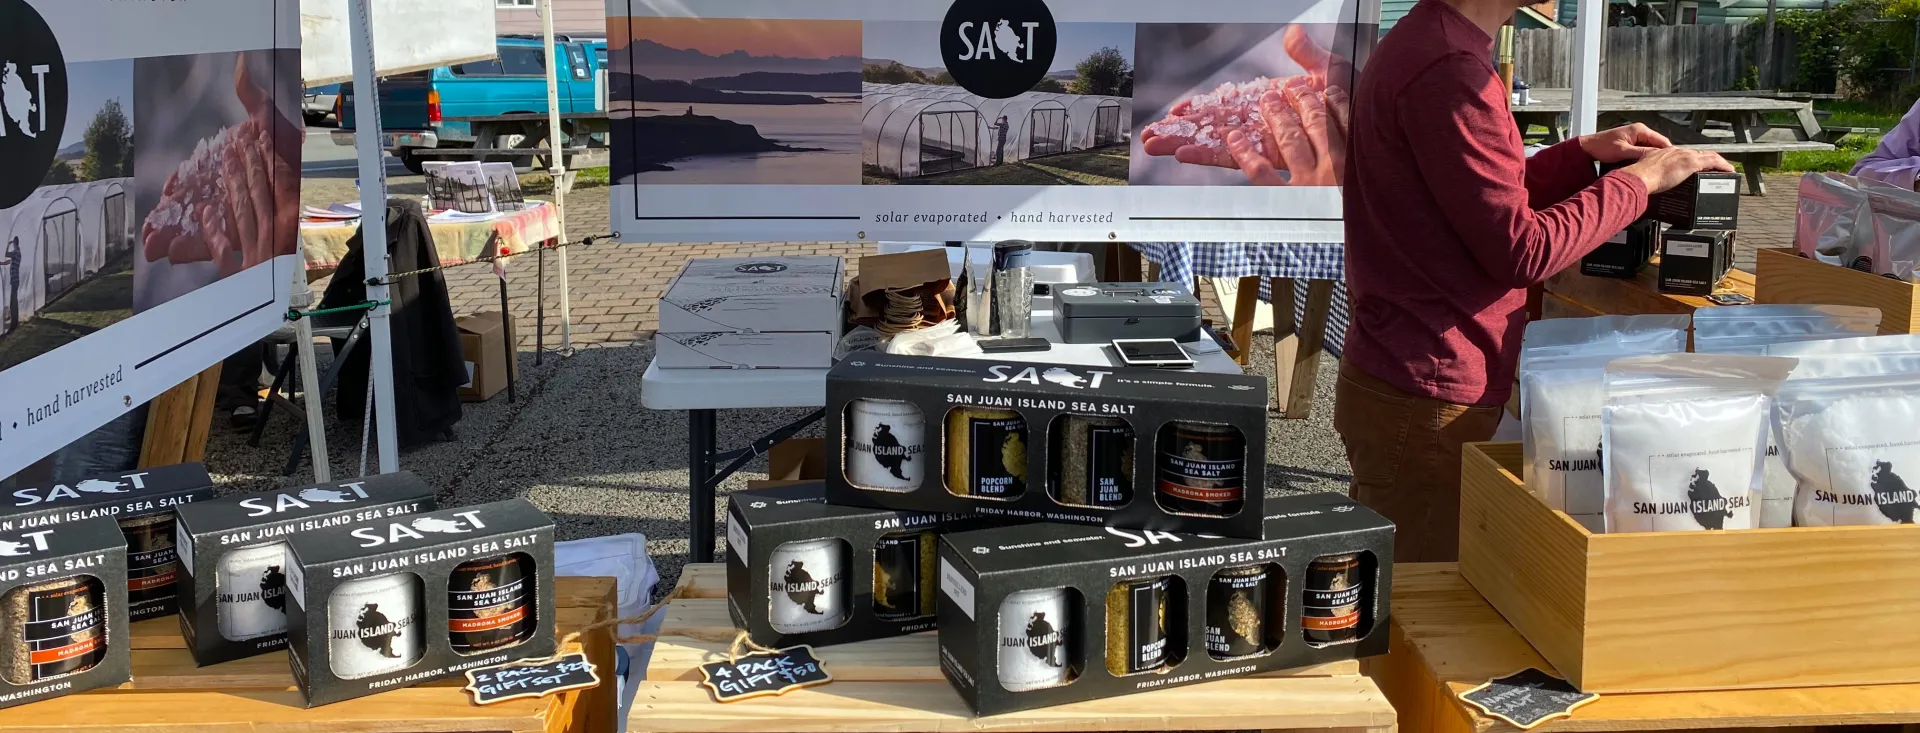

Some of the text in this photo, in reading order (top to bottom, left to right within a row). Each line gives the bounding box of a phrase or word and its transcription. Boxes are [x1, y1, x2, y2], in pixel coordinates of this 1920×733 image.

[875, 212, 1114, 225] solar evaporated hand harvested
[27, 364, 122, 426] hand harvested
[947, 394, 1135, 414] SAN JUAN ISLAND SEA SALT
[855, 443, 921, 456] JUAN ISLAND SEA
[1170, 458, 1184, 466] SAN
[1186, 462, 1206, 470] JUAN
[1549, 459, 1596, 471] SAN JUAN
[1184, 468, 1200, 476] SEA
[981, 477, 1013, 485] POPCORN
[1100, 477, 1115, 485] SAN
[981, 485, 1005, 493] BLEND
[1100, 485, 1118, 493] JUAN
[1173, 487, 1204, 497] MADRONA
[1815, 489, 1914, 505] SAN JUAN ISLAND
[20, 514, 60, 529] JUAN
[66, 506, 119, 522] ISLAND
[127, 501, 153, 512] SEA
[159, 495, 194, 507] SALT
[1633, 496, 1744, 514] SAN JUAN ISLAND SEA
[874, 514, 937, 529] SAN JUAN
[975, 507, 1103, 522] FRIDAY HARBOR, WASHINGTON
[221, 503, 419, 545] SAN JUAN ISLAND SEA SALT
[998, 541, 1042, 551] Sunshine
[1062, 535, 1106, 544] seawater.
[154, 549, 174, 557] JUAN
[332, 534, 538, 578] SAN JUAN ISLAND SEA SALT
[26, 563, 58, 577] SEA
[64, 554, 104, 570] SALT
[1109, 547, 1287, 577] SAN JUAN ISLAND SEA SALT
[142, 575, 174, 585] MADRONA
[1250, 573, 1266, 582] ISLAND
[475, 591, 496, 600] JUAN
[499, 583, 522, 595] ISLAND
[786, 579, 833, 593] ISLAND SEA
[218, 591, 259, 602] SAN JUAN
[492, 594, 510, 603] SALT
[1333, 591, 1350, 600] JUAN
[1346, 594, 1358, 604] SALT
[130, 605, 164, 616] INGTON
[51, 613, 93, 629] SAN JUAN
[71, 622, 86, 631] SEA
[462, 612, 521, 628] MADRONA SMOKED
[1320, 618, 1348, 626] MADRONA
[333, 629, 356, 639] JUAN
[361, 622, 394, 639] ISLAND
[397, 617, 410, 629] SEA
[902, 624, 928, 632] FRIDAY
[1205, 626, 1220, 635] SAN
[257, 638, 288, 648] FRIDAY
[1002, 637, 1025, 647] JUAN
[1029, 631, 1057, 647] ISLAND
[58, 641, 93, 656] MADRONA
[1142, 649, 1162, 661] BLEND
[368, 655, 507, 690] FRIDAY HARBOR, WASHINGTON
[716, 656, 794, 677] 4 PACK
[476, 673, 491, 682] 2
[496, 667, 548, 682] PACK
[720, 670, 779, 693] GIFT
[1137, 665, 1257, 689] FRIDAY HARBOR, WASHINGTON
[479, 673, 570, 694] GIFT SET
